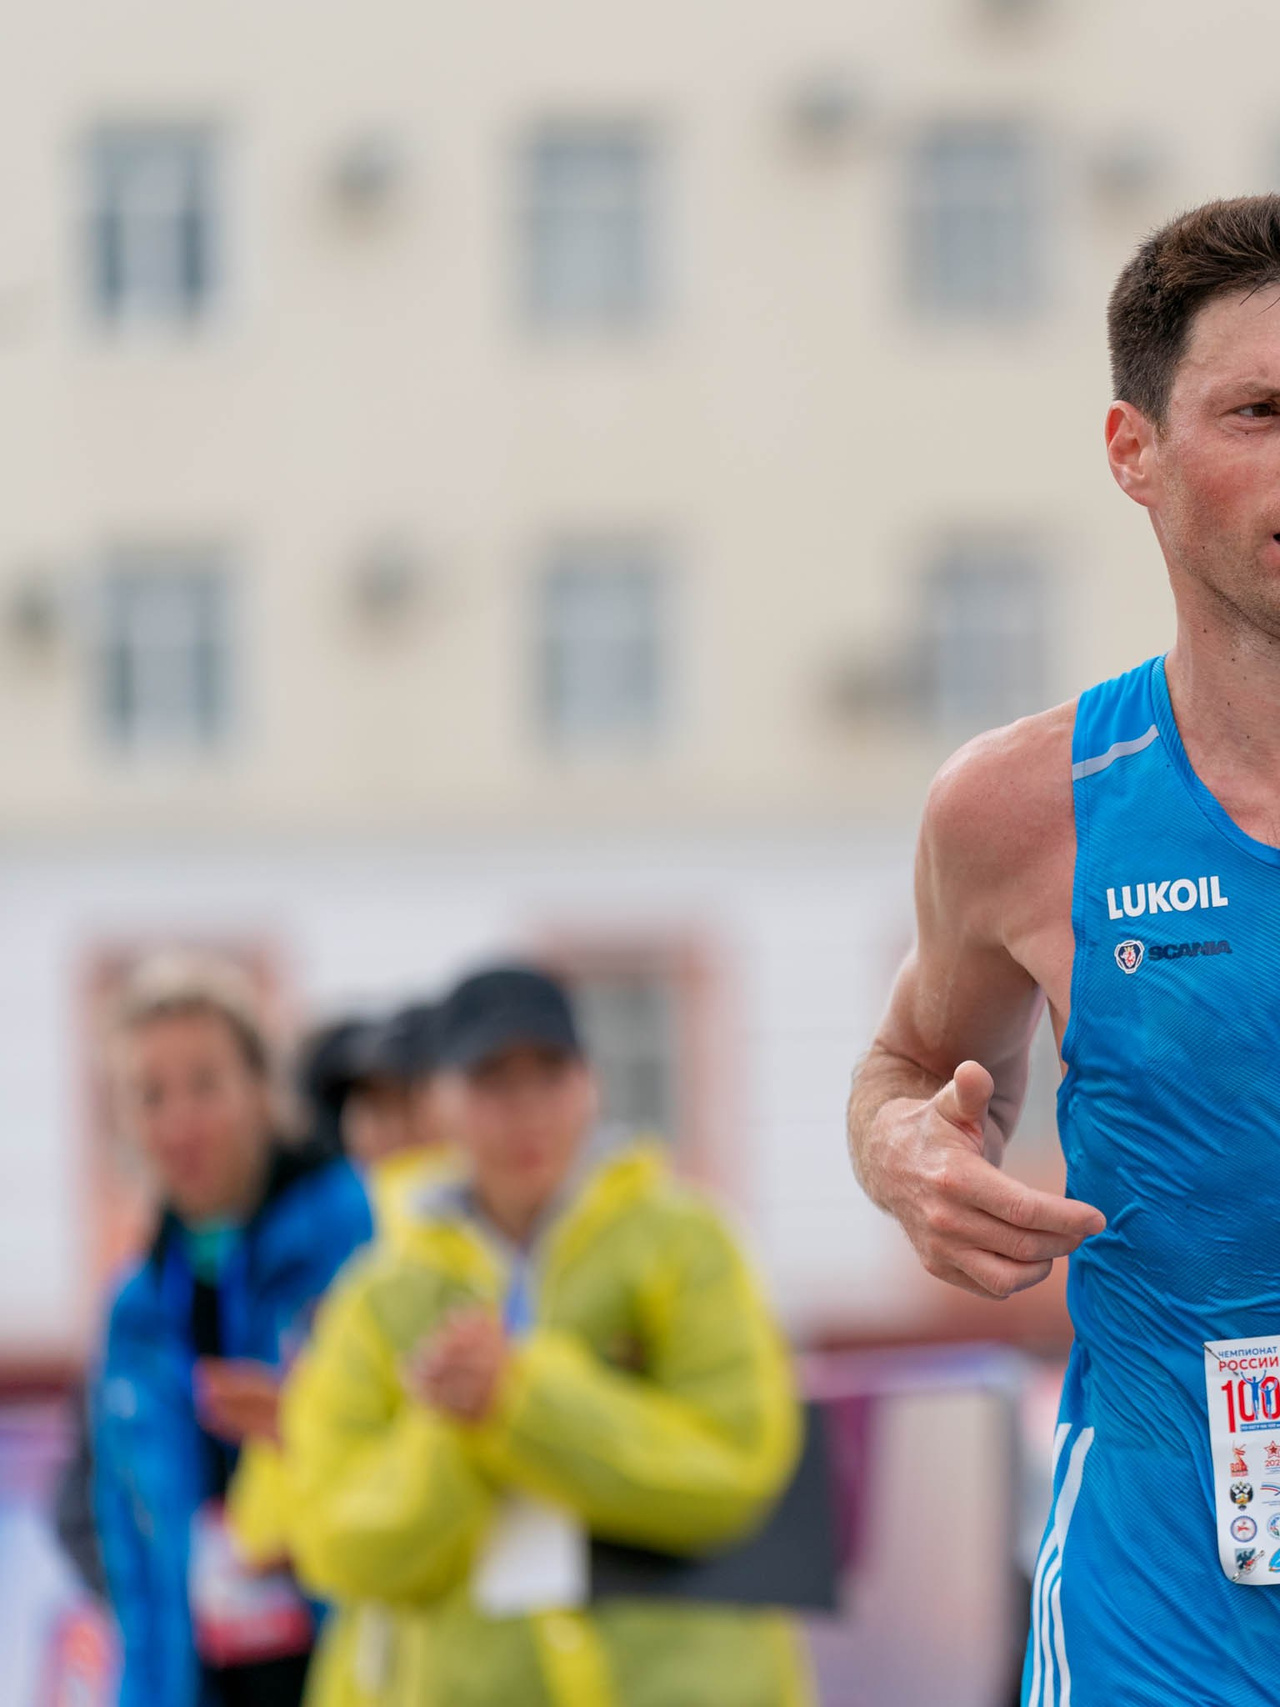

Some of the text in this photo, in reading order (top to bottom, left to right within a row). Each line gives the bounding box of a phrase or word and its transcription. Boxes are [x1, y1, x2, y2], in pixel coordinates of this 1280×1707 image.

[1106, 875, 1229, 920] LUKOIL
[1148, 940, 1232, 961] SCANIA
[1218, 1346, 1278, 1358] ЧЕМПИОНАТ
[1218, 1356, 1279, 1372] РОССИИ
